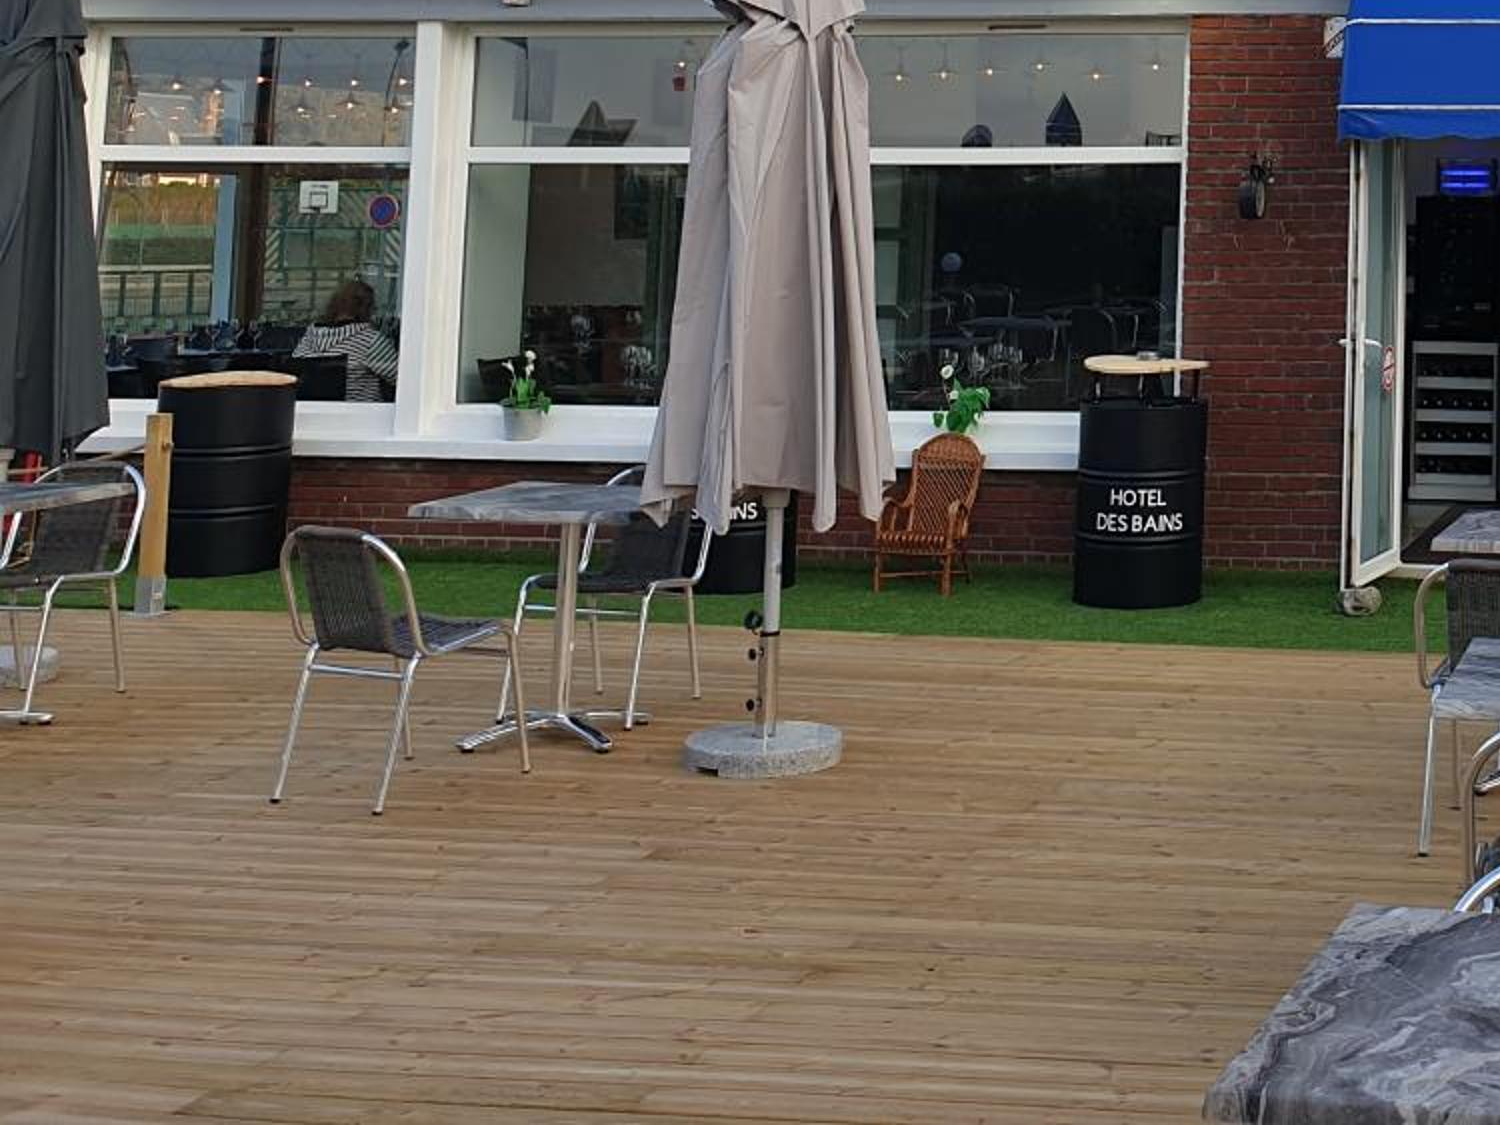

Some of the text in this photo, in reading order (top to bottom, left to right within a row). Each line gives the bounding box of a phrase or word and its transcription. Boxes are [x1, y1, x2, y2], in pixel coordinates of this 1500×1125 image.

[1110, 488, 1167, 506] HOTEL
[1096, 512, 1183, 532] DES BAINS
